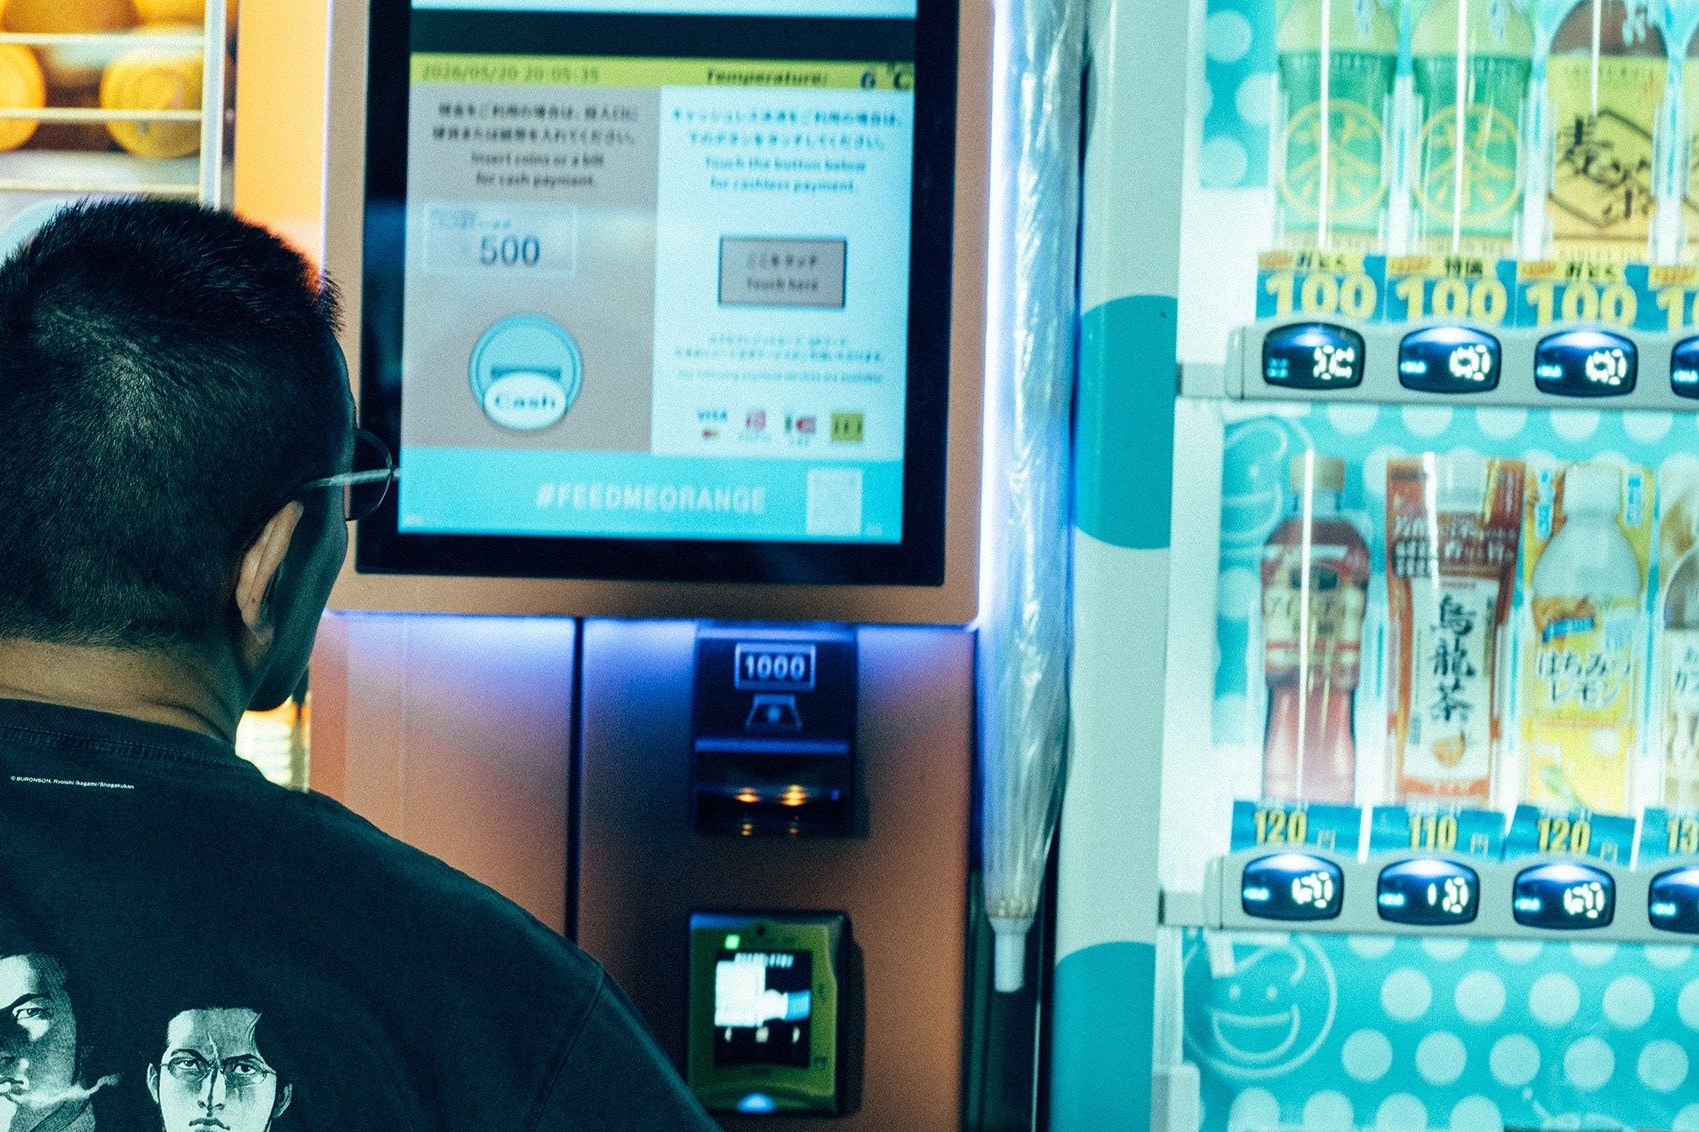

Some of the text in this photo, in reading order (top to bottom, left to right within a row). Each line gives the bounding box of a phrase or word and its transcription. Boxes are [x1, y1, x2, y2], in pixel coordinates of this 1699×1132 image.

[479, 234, 541, 267] 500
[1265, 271, 1378, 319] 100
[1395, 276, 1508, 323] 100
[1526, 282, 1638, 331] 100
[536, 483, 767, 515] #FEEDMEORANGE
[745, 655, 805, 682] 1000
[1253, 810, 1308, 846] 120
[1408, 815, 1457, 851] 110
[1537, 819, 1591, 855] 120
